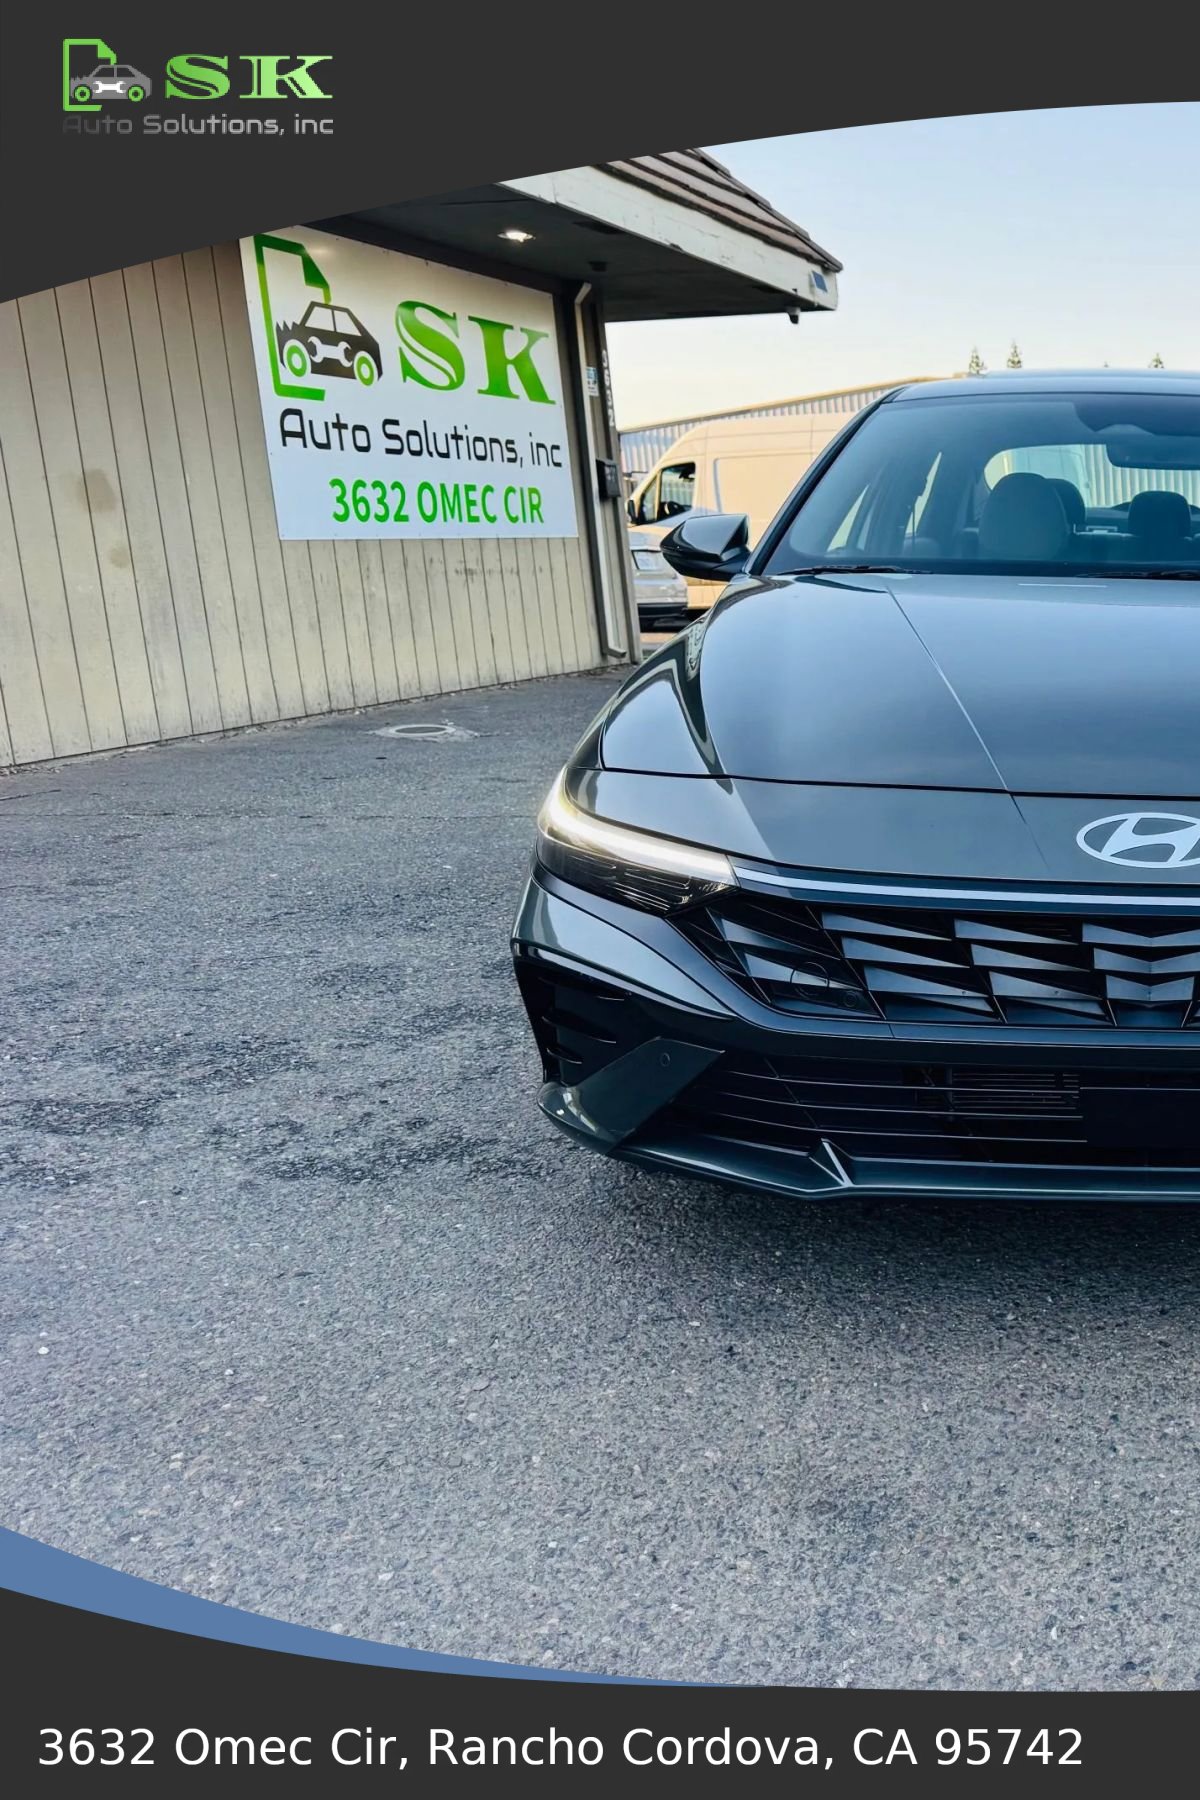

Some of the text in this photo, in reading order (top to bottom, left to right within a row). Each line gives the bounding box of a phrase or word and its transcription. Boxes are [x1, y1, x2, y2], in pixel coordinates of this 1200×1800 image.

[395, 300, 556, 405] SK
[279, 407, 563, 468] Auto Solutions, inc
[328, 477, 545, 524] 3632 OMEC CIR
